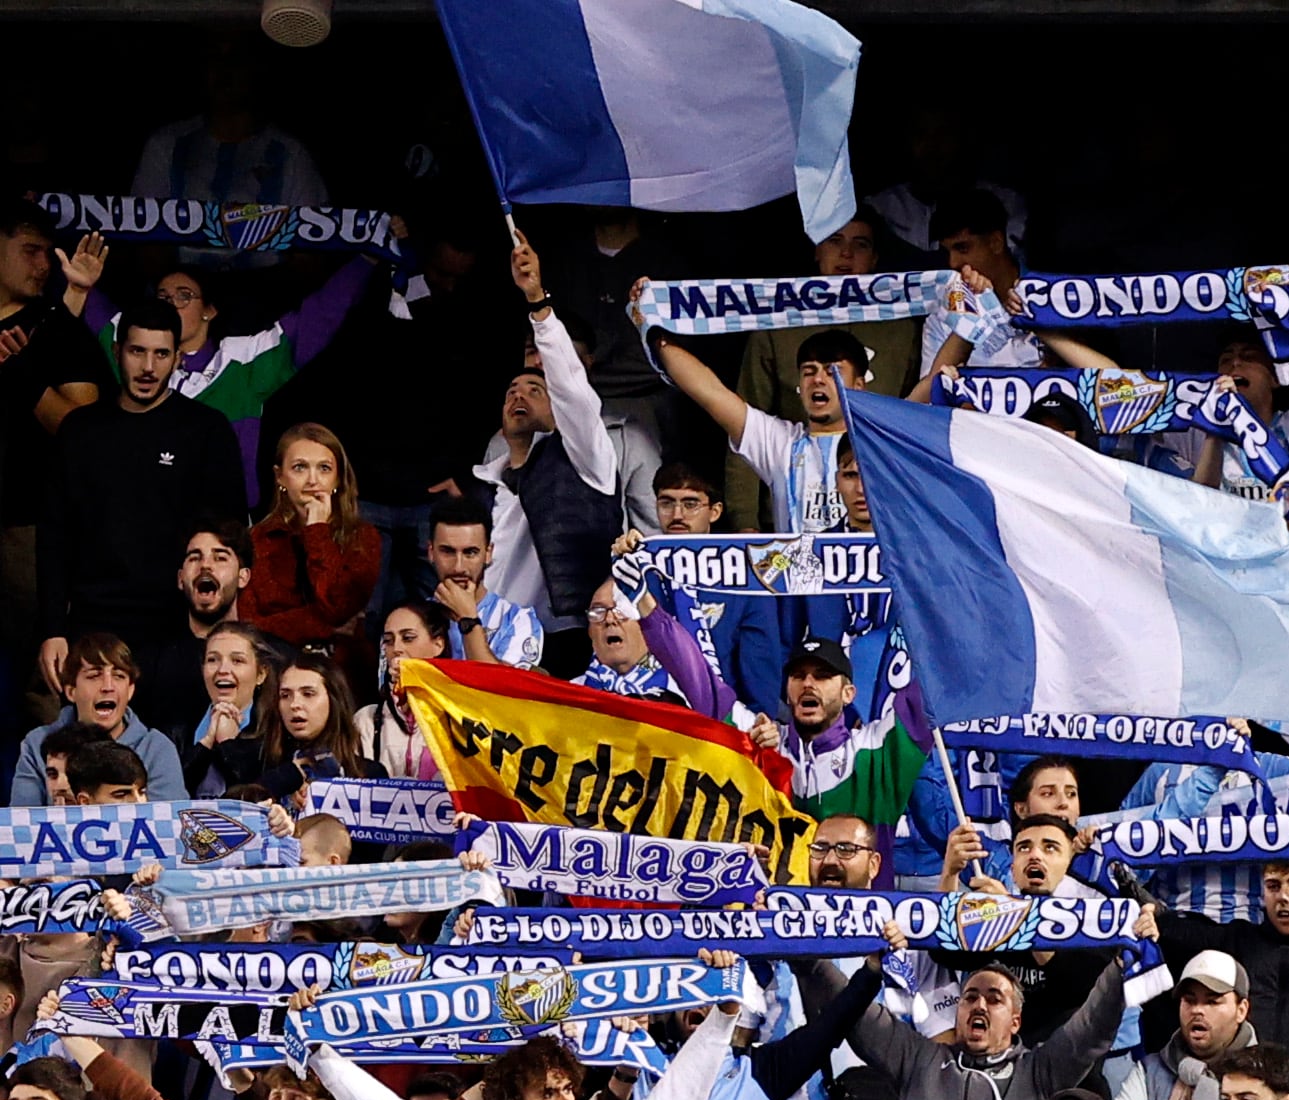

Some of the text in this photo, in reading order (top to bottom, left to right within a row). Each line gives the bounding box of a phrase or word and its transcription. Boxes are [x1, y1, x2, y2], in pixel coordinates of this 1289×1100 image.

[42, 193, 204, 237] ONDO
[1019, 270, 1228, 320] FONDO
[496, 819, 755, 900] Malaga
[600, 912, 678, 943] DIJO
[683, 911, 764, 940] UNA
[775, 909, 886, 939] GITAN
[580, 964, 710, 1009] SUR
